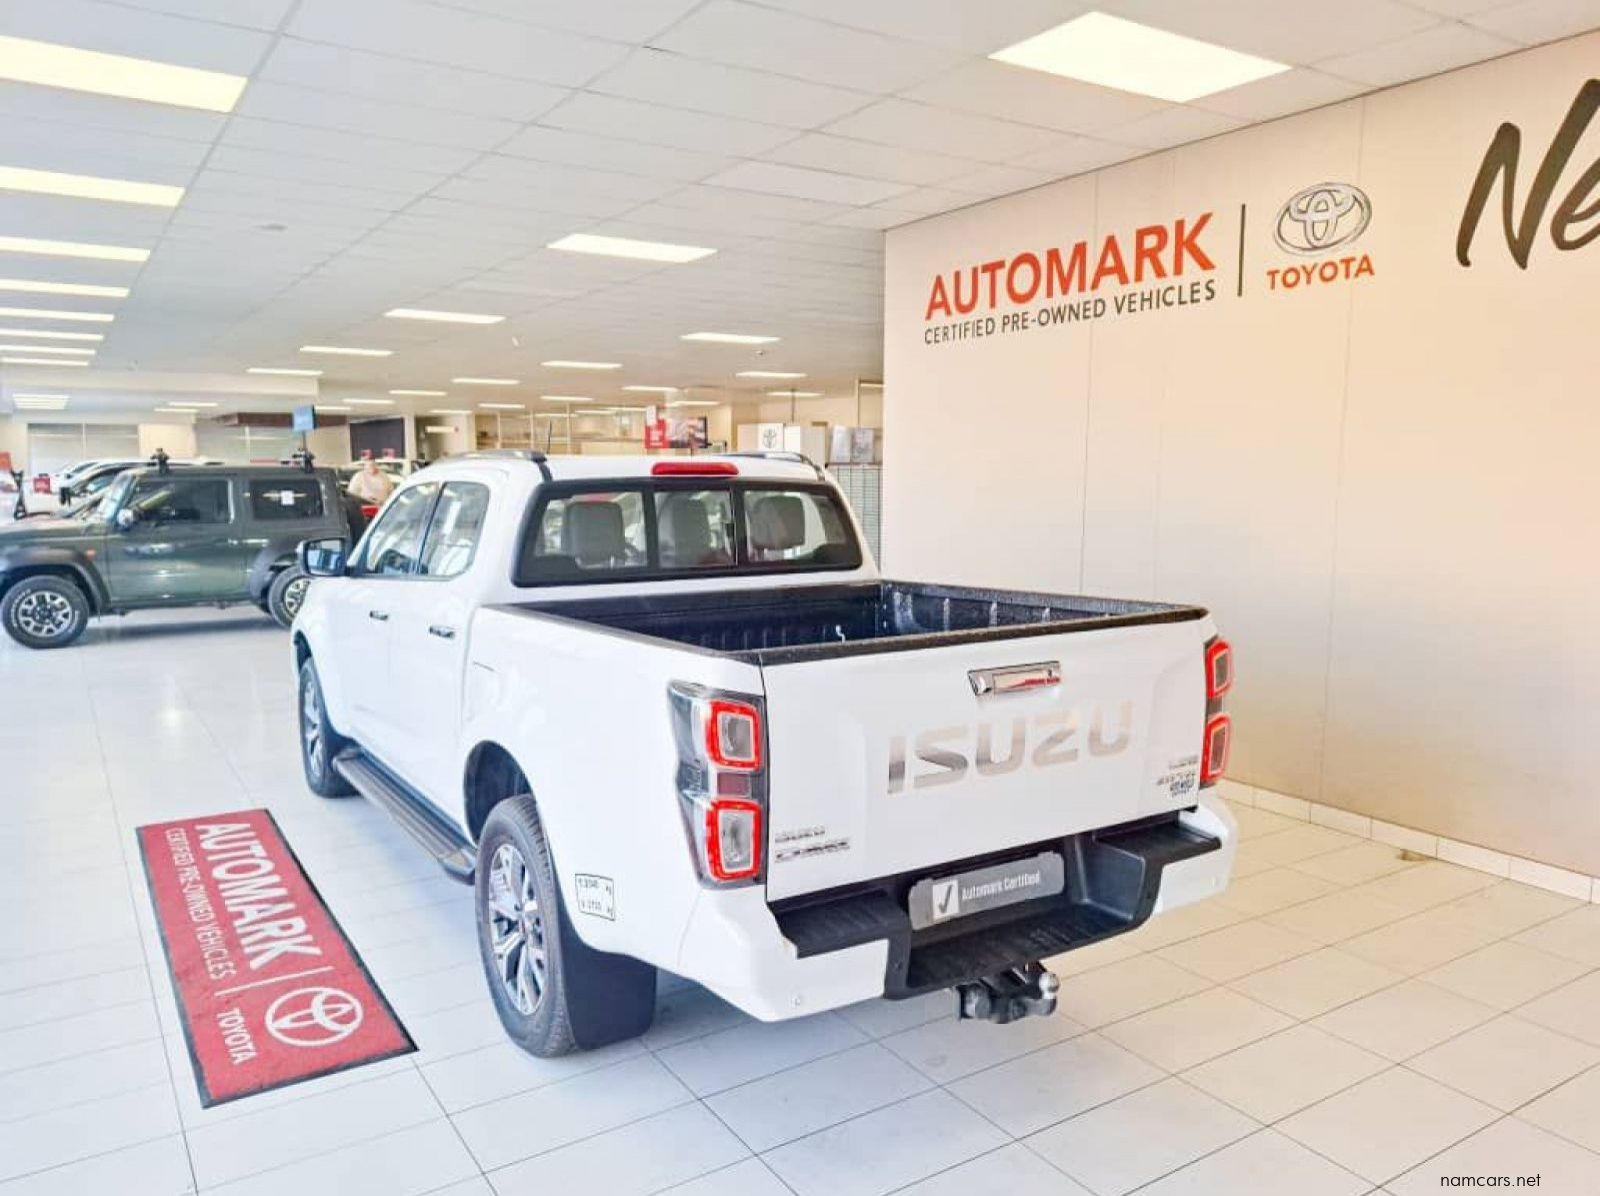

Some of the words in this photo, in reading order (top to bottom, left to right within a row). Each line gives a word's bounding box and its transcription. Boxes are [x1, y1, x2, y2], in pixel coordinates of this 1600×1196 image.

[925, 212, 1216, 320] AUTOMARK
[1266, 255, 1375, 290] TOYOTA
[924, 317, 996, 344] CERTIFIED
[1001, 297, 1106, 333] PRE-OWNED
[1114, 279, 1216, 315] VEHICLES
[887, 699, 1133, 795] ISUZU
[165, 827, 195, 867] CERTIFIED
[195, 921, 237, 980] VEHICLES
[195, 823, 323, 970] AUTOMARK
[962, 880, 1003, 900] Automark
[1004, 870, 1041, 889] Certified
[216, 1007, 257, 1065] TOYOTA
